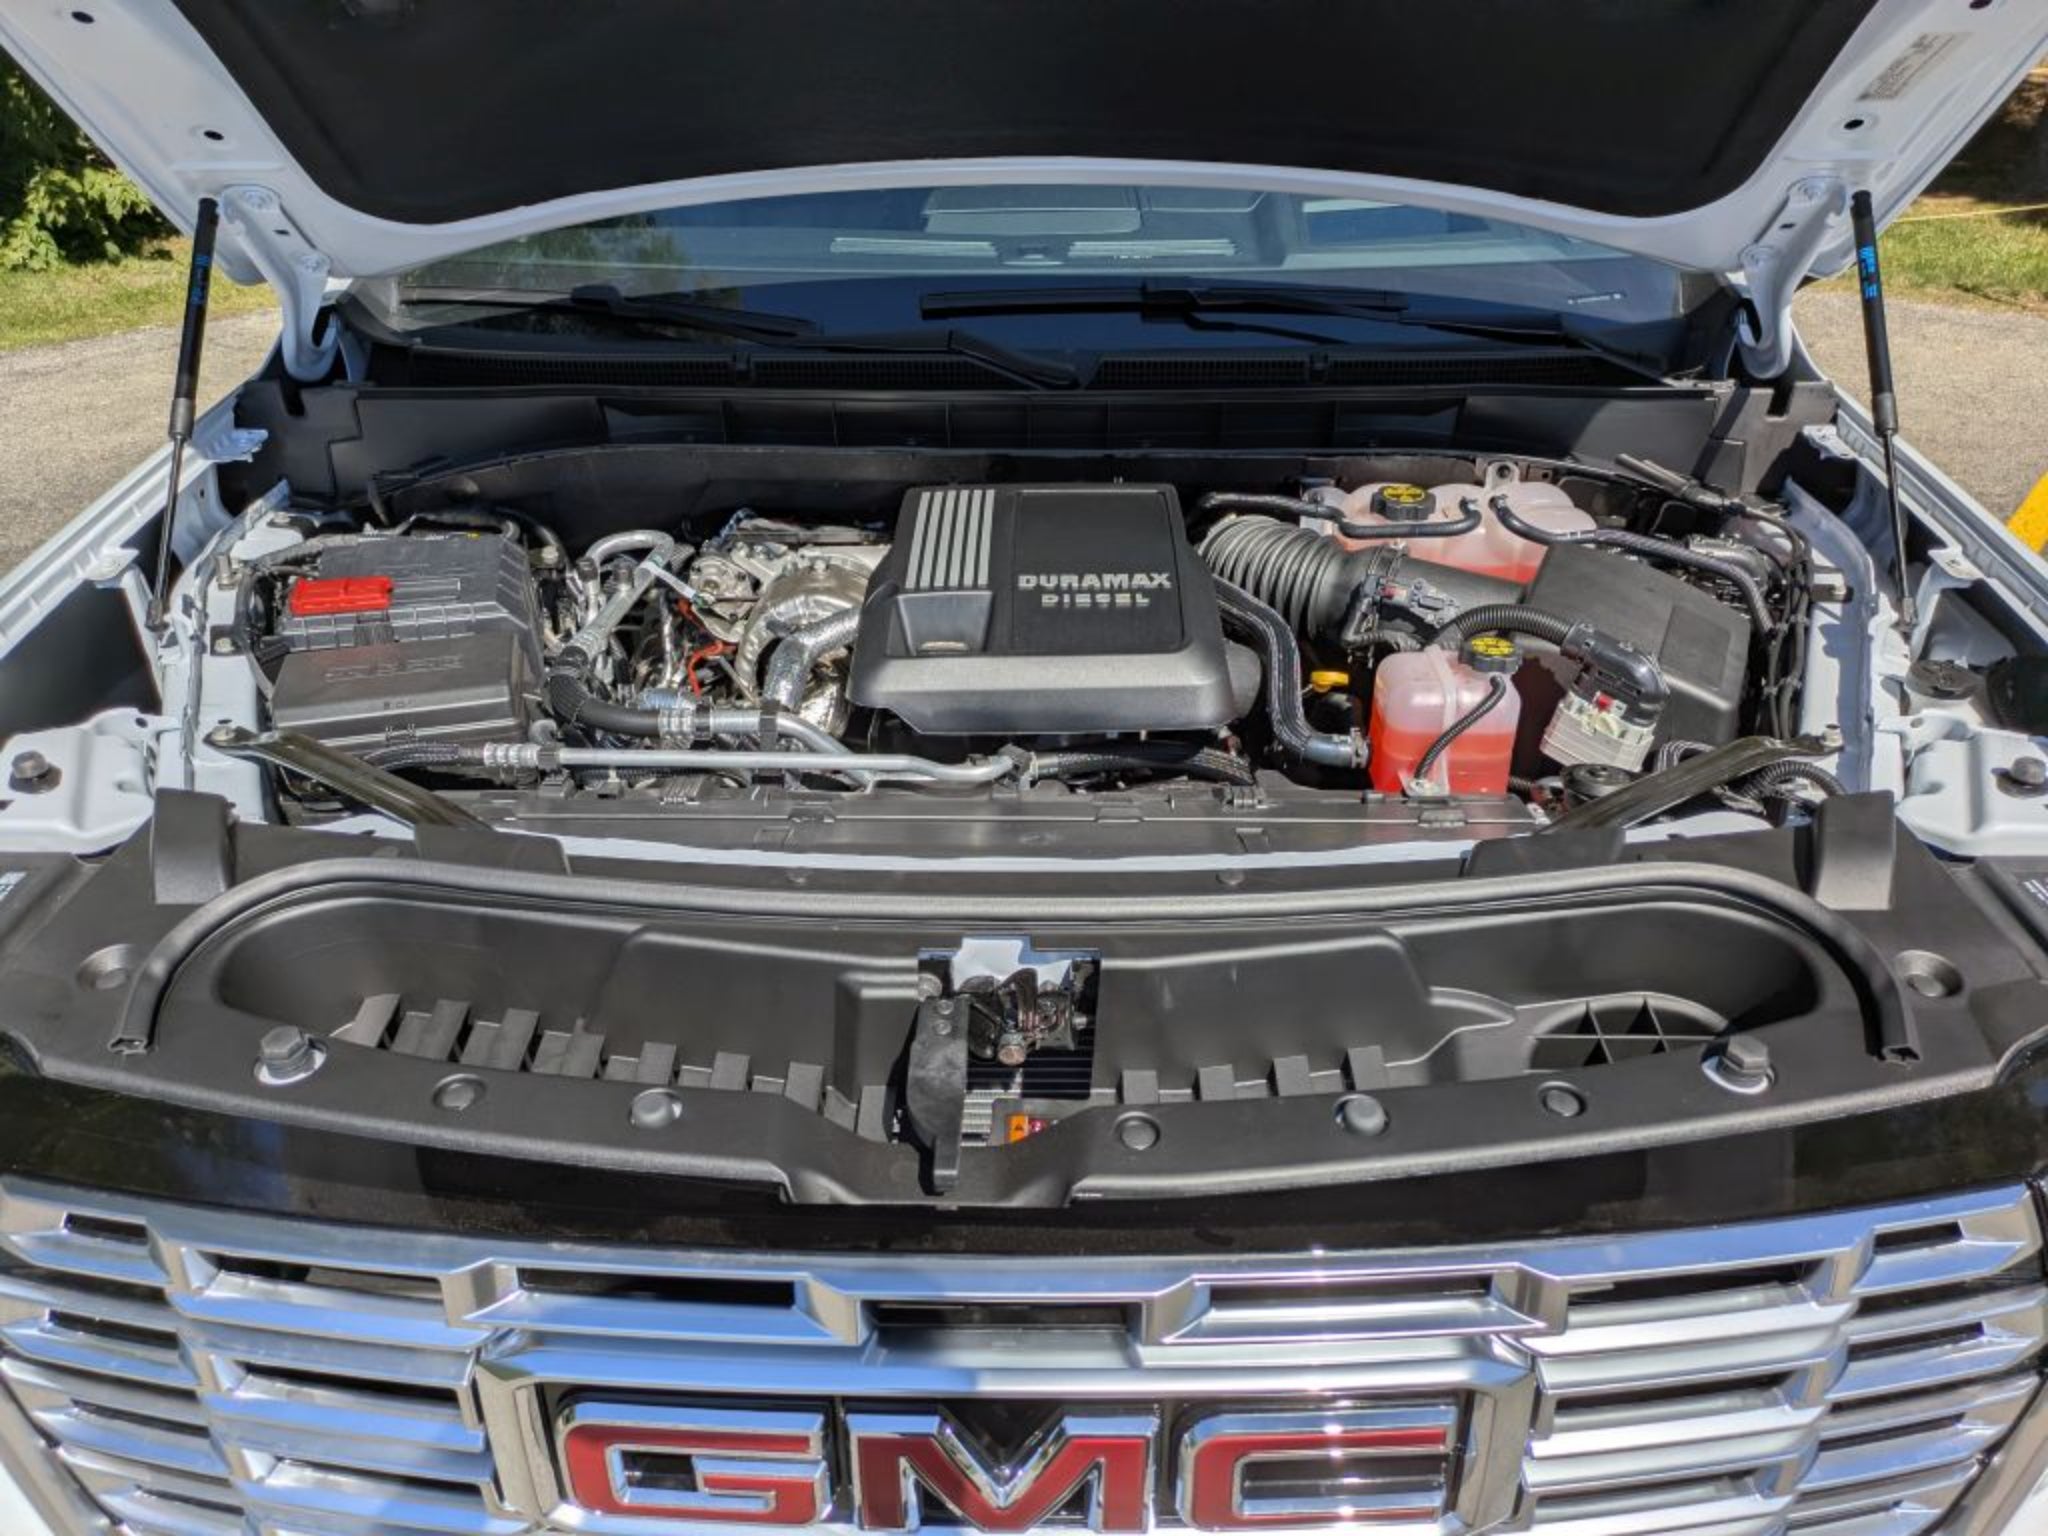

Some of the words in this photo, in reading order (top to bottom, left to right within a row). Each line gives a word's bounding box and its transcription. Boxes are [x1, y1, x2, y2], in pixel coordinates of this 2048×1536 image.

[1018, 573, 1172, 590] DURAMAX
[1041, 593, 1150, 607] DIESEL
[556, 1402, 1457, 1532] GMC
